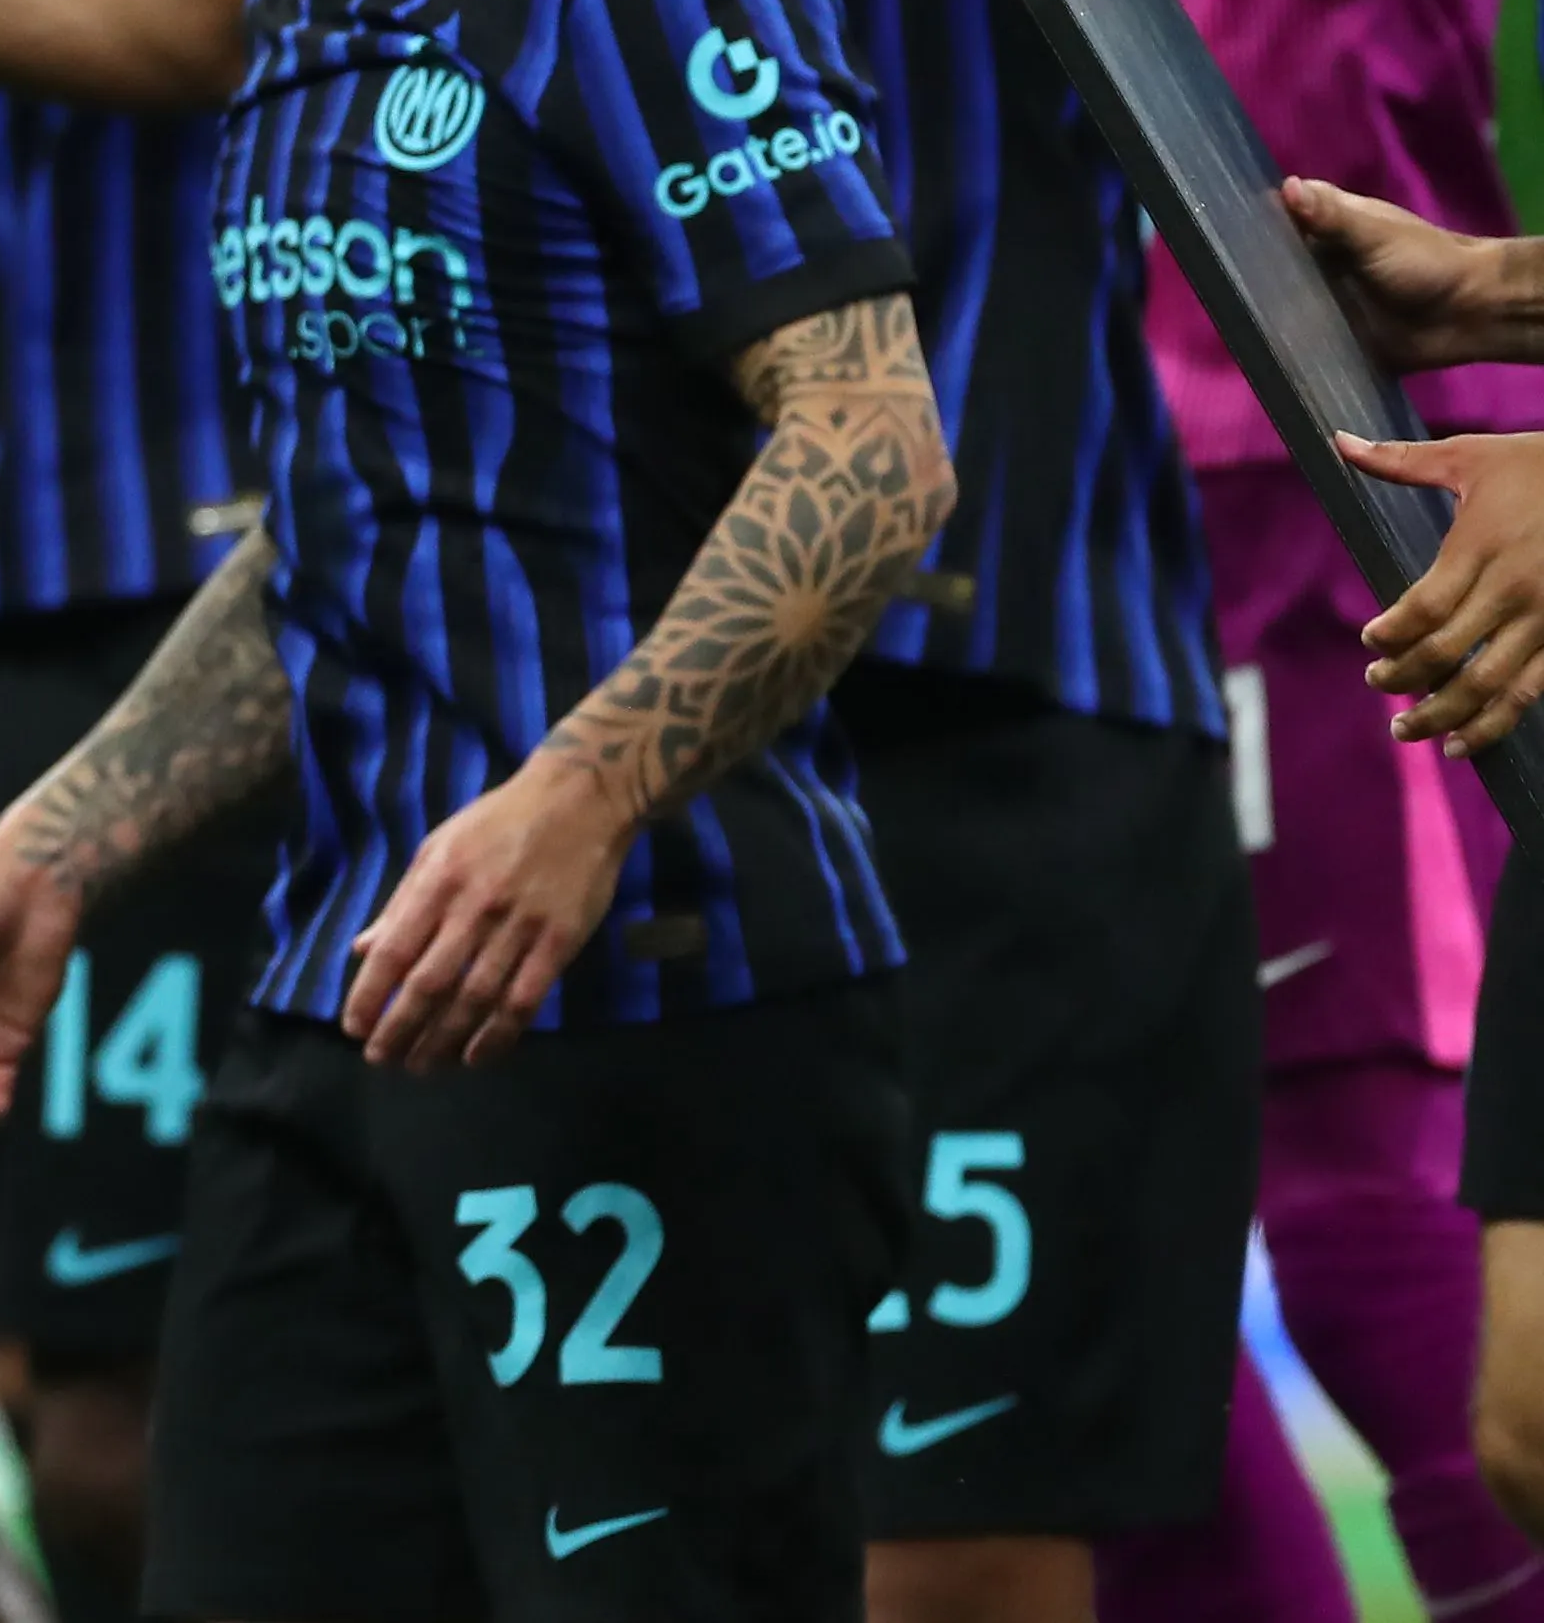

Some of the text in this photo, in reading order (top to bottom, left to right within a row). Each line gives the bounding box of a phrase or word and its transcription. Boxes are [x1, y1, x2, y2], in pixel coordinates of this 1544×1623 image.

[211, 194, 474, 310] etsson
[655, 109, 862, 220] Gate.io
[43, 950, 205, 1145] 14
[454, 1182, 666, 1386] 32
[867, 1131, 1032, 1332] 5
